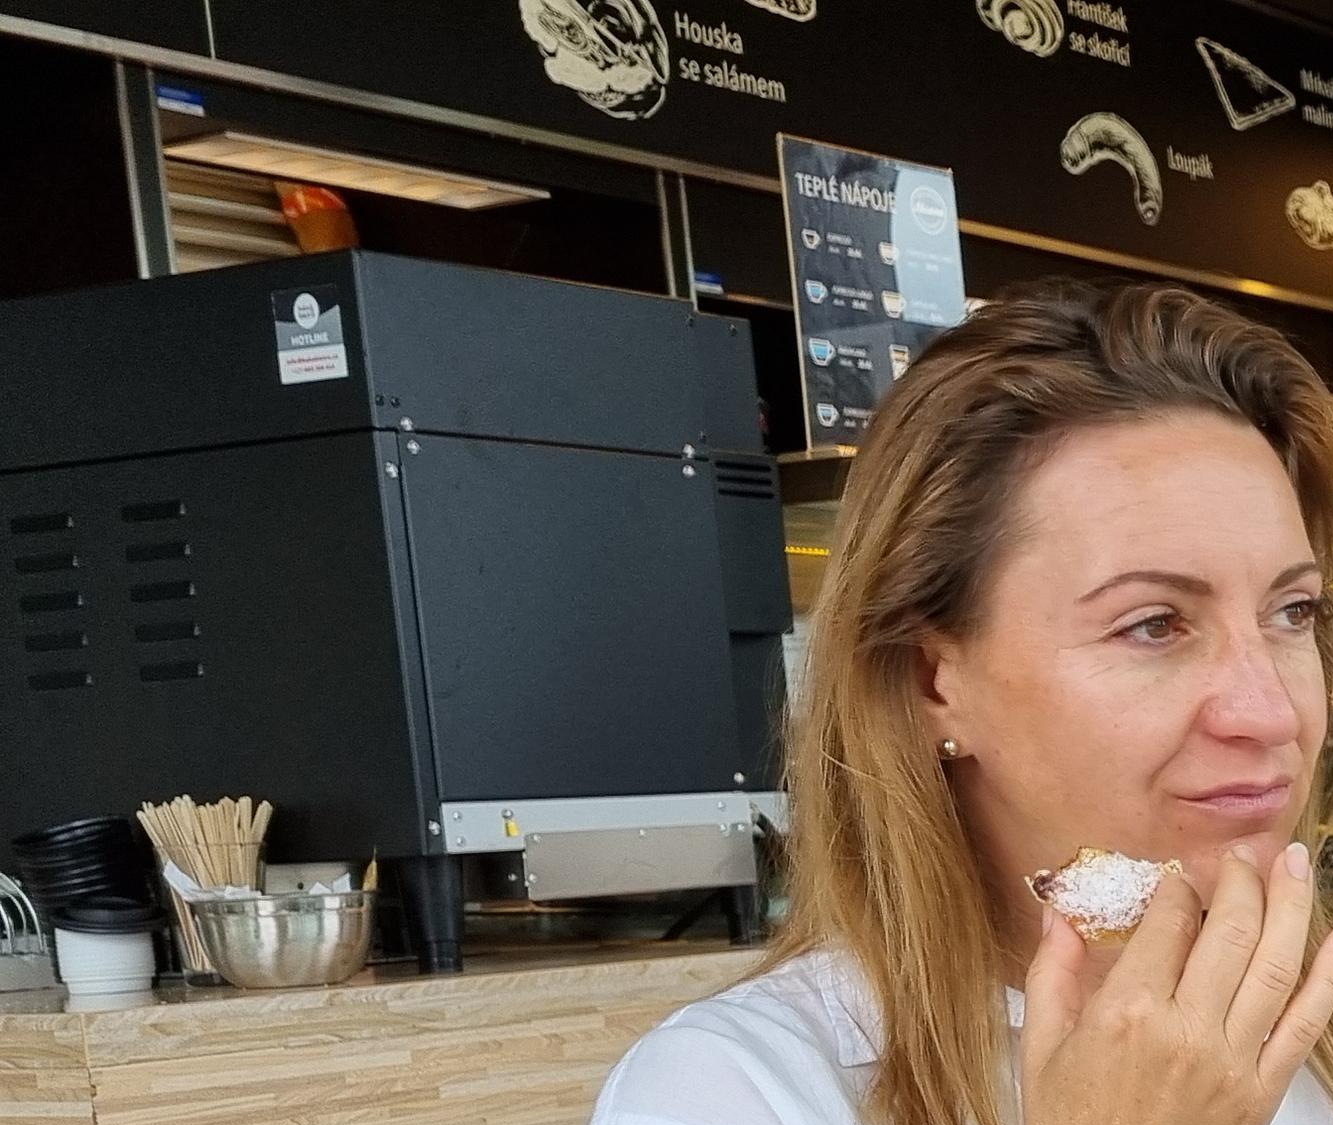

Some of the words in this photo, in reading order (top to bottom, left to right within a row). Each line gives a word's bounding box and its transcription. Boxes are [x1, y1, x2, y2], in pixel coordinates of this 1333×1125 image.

[674, 10, 744, 54] Houska
[679, 56, 700, 80] se
[703, 60, 787, 103] salámem
[1167, 145, 1214, 181] Loupák
[795, 171, 840, 204] TEPLÉ
[841, 180, 897, 215] NÁPOJE
